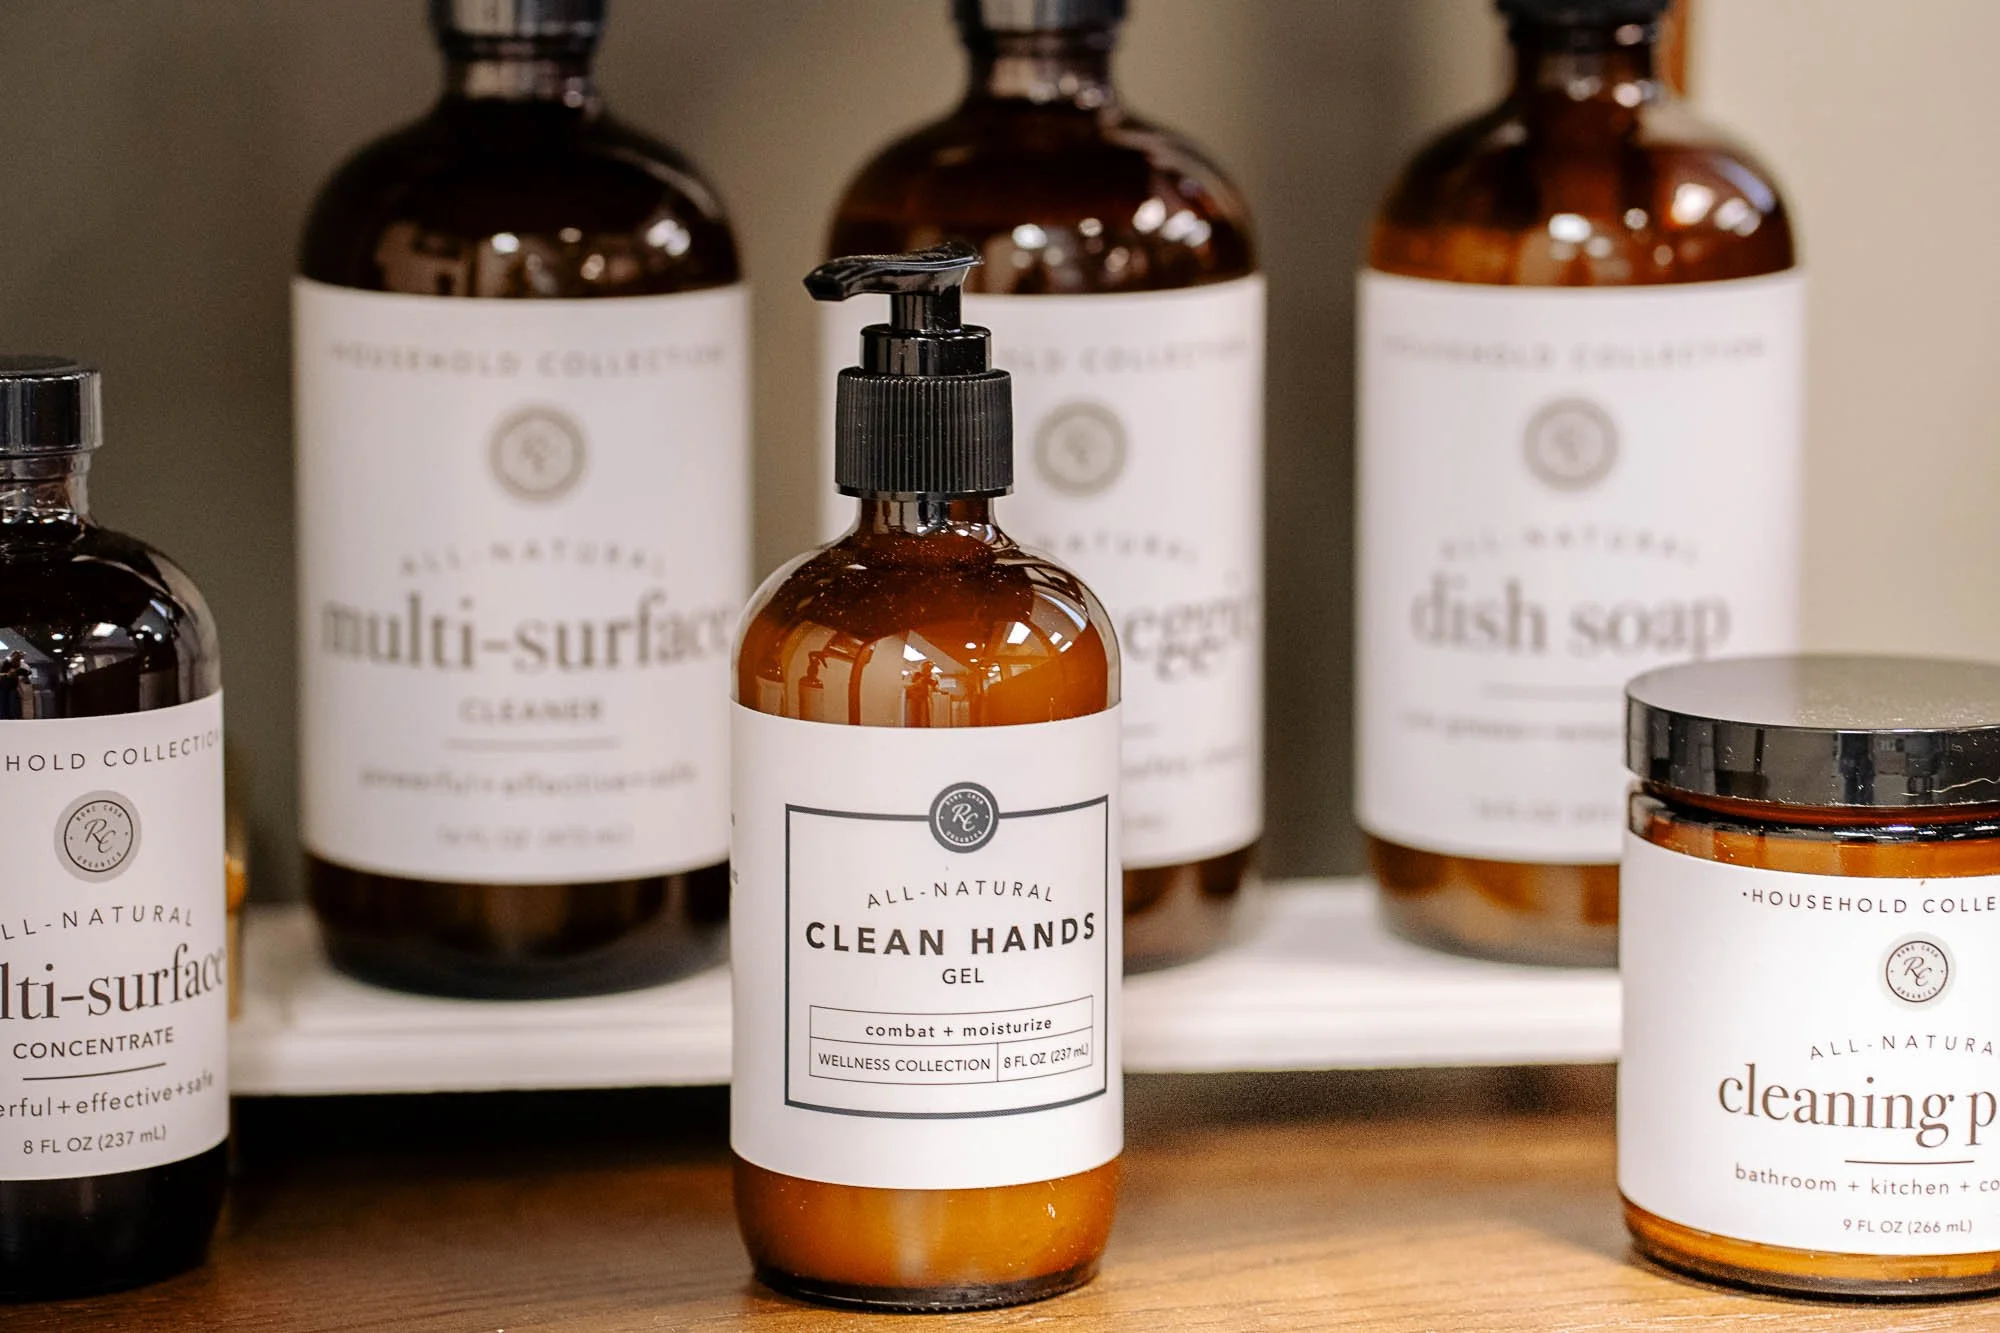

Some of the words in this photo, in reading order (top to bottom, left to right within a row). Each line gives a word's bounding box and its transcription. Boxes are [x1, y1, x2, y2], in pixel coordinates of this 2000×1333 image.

[1409, 572, 1549, 656] dish
[1567, 595, 1732, 661] soap
[459, 698, 604, 725] CLEANER
[867, 879, 1054, 909] ALL-NATURAL
[806, 920, 945, 956] CLEAN
[970, 912, 1096, 956] HANDS
[941, 968, 985, 985] GEL
[865, 1023, 936, 1038] combat
[962, 1018, 1052, 1037] moisturize
[13, 1027, 175, 1060] CONCENTRATE
[1003, 1056, 1011, 1069] 8
[1014, 1055, 1028, 1067] FL
[1030, 1052, 1047, 1066] OZ
[1050, 1047, 1072, 1064] (237
[818, 1053, 890, 1072] WELLNESS
[895, 1058, 991, 1073] COLLECTION
[1717, 1062, 1955, 1149] cleaning
[23, 1139, 34, 1155] 8
[41, 1138, 61, 1155] FL
[67, 1135, 93, 1153] OZ
[98, 1130, 135, 1152] (237
[140, 1123, 168, 1143] mL)
[1734, 1161, 1837, 1193] bathroom
[1870, 1177, 1950, 1196] kitchen
[1843, 1218, 1852, 1231] 9
[1857, 1219, 1876, 1233] FL
[1880, 1220, 1903, 1234] OZ
[1907, 1220, 1941, 1235] (266
[1946, 1218, 1973, 1233] mL)
